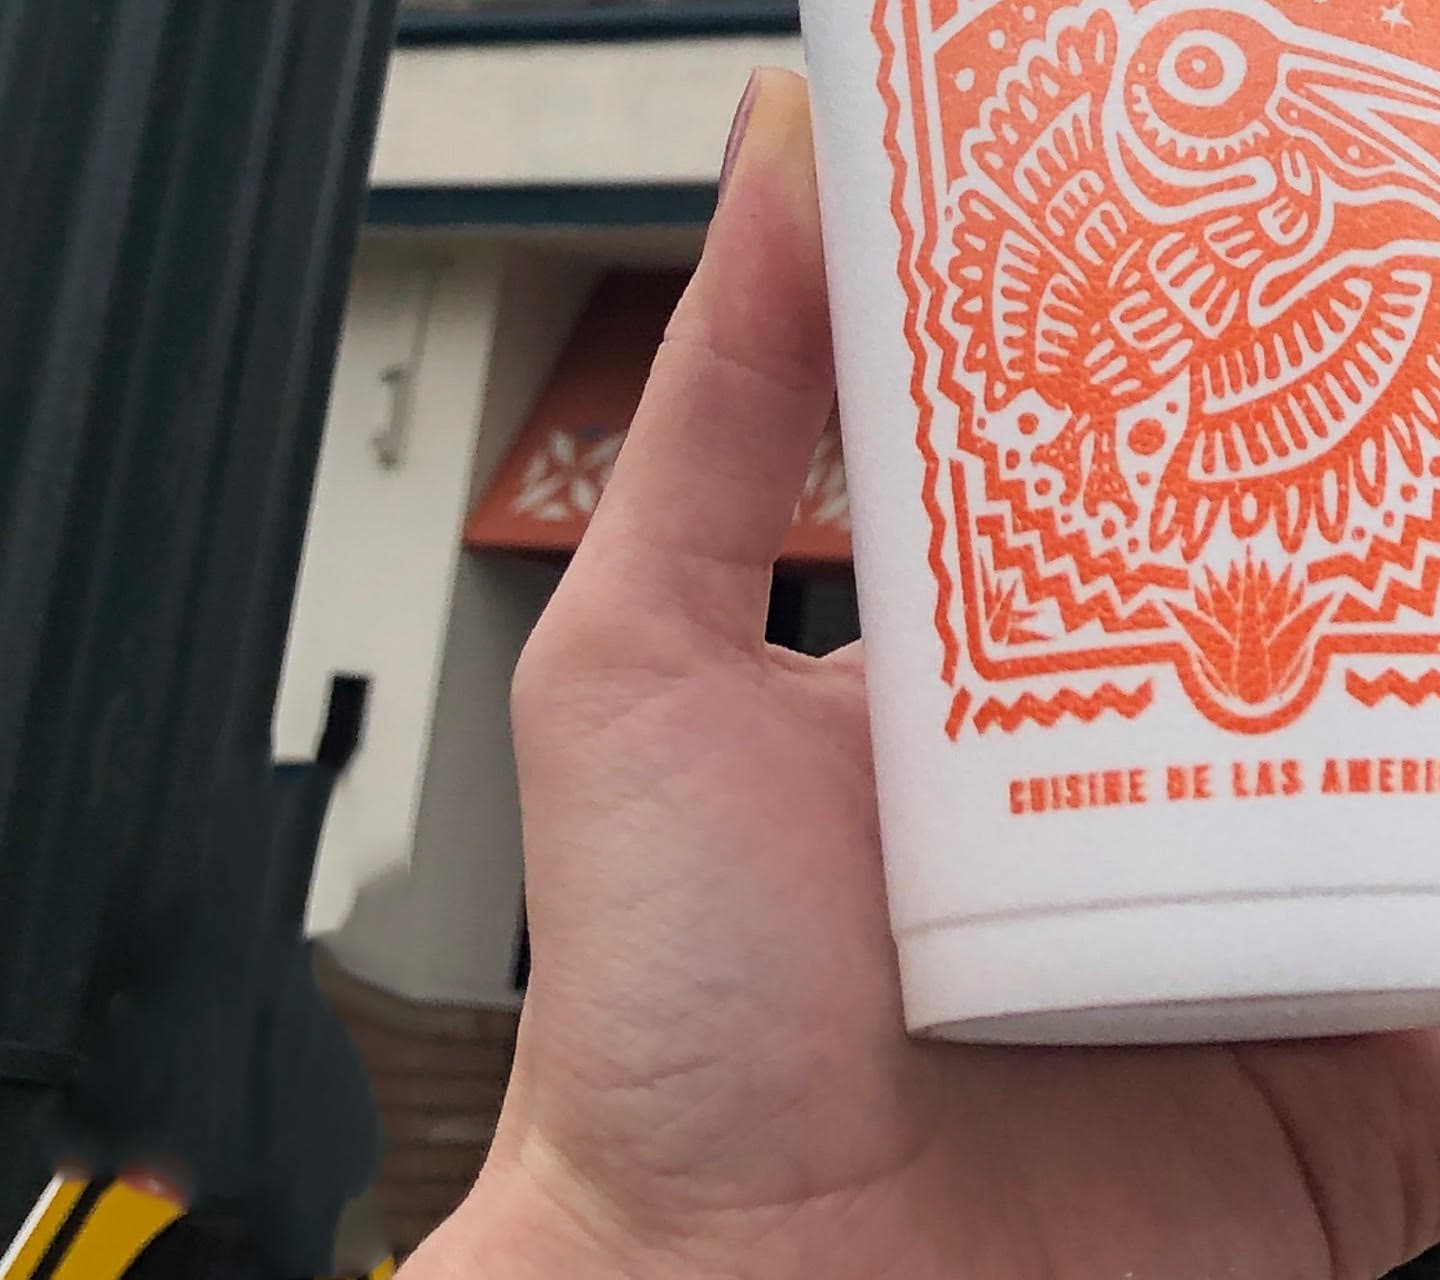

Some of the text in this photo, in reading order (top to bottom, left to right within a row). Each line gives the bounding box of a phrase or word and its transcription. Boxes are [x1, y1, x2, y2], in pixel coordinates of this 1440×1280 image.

[1009, 768, 1148, 814] CUISINE
[1165, 763, 1212, 801] DE
[1231, 758, 1303, 799] LAS
